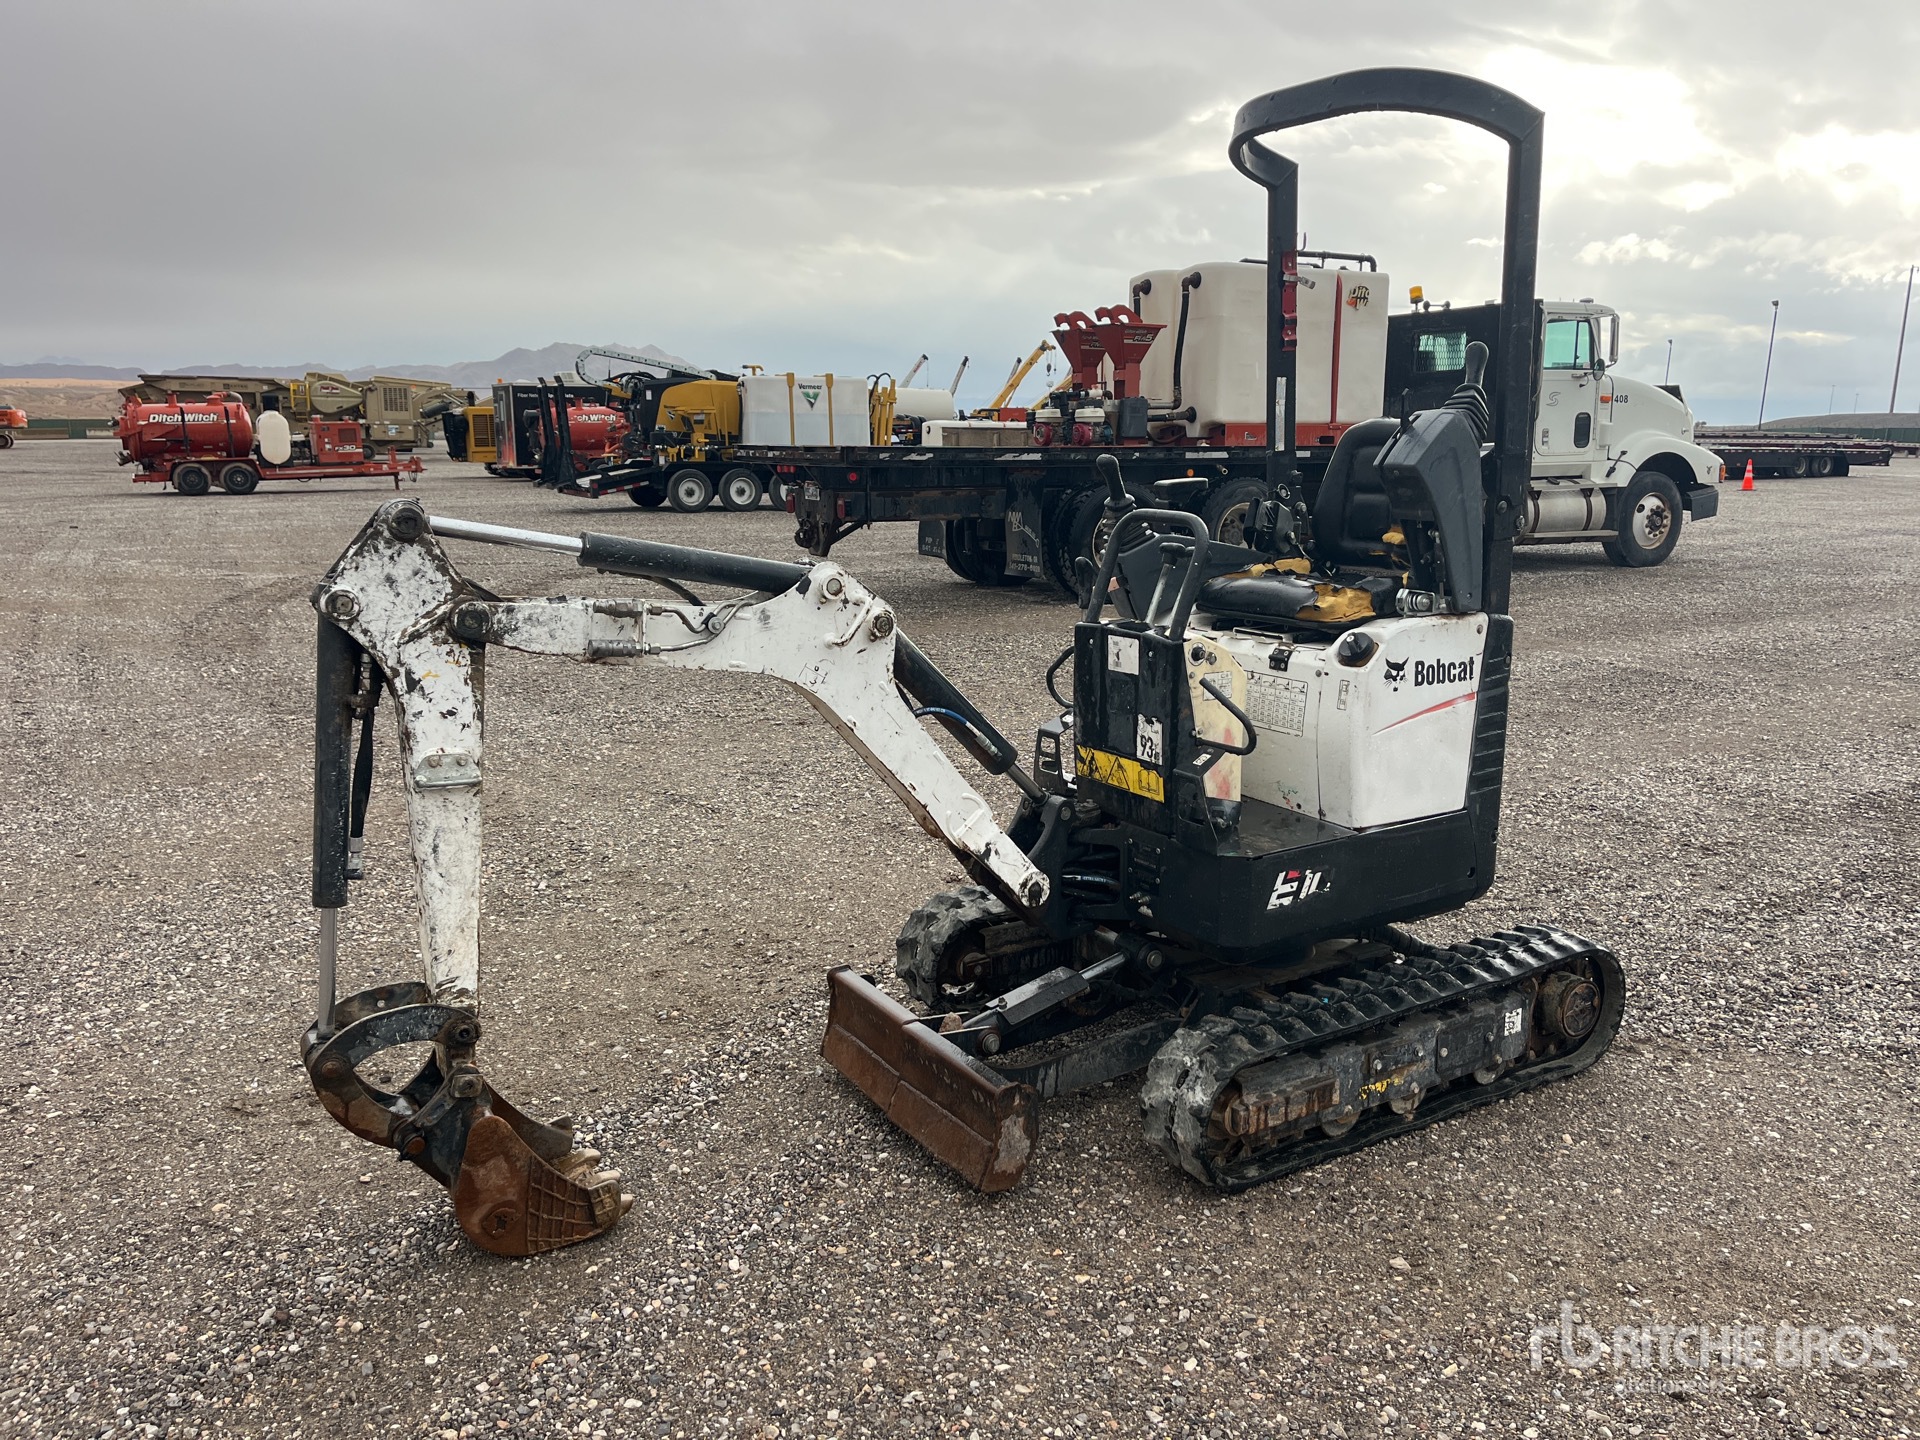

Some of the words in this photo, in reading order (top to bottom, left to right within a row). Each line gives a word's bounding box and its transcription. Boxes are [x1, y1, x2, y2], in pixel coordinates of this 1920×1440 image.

[1614, 395, 1628, 403] 408
[149, 413, 181, 423] Ditch
[184, 413, 217, 422] Witch
[1414, 656, 1475, 687] Bobcat
[1140, 734, 1153, 759] 93
